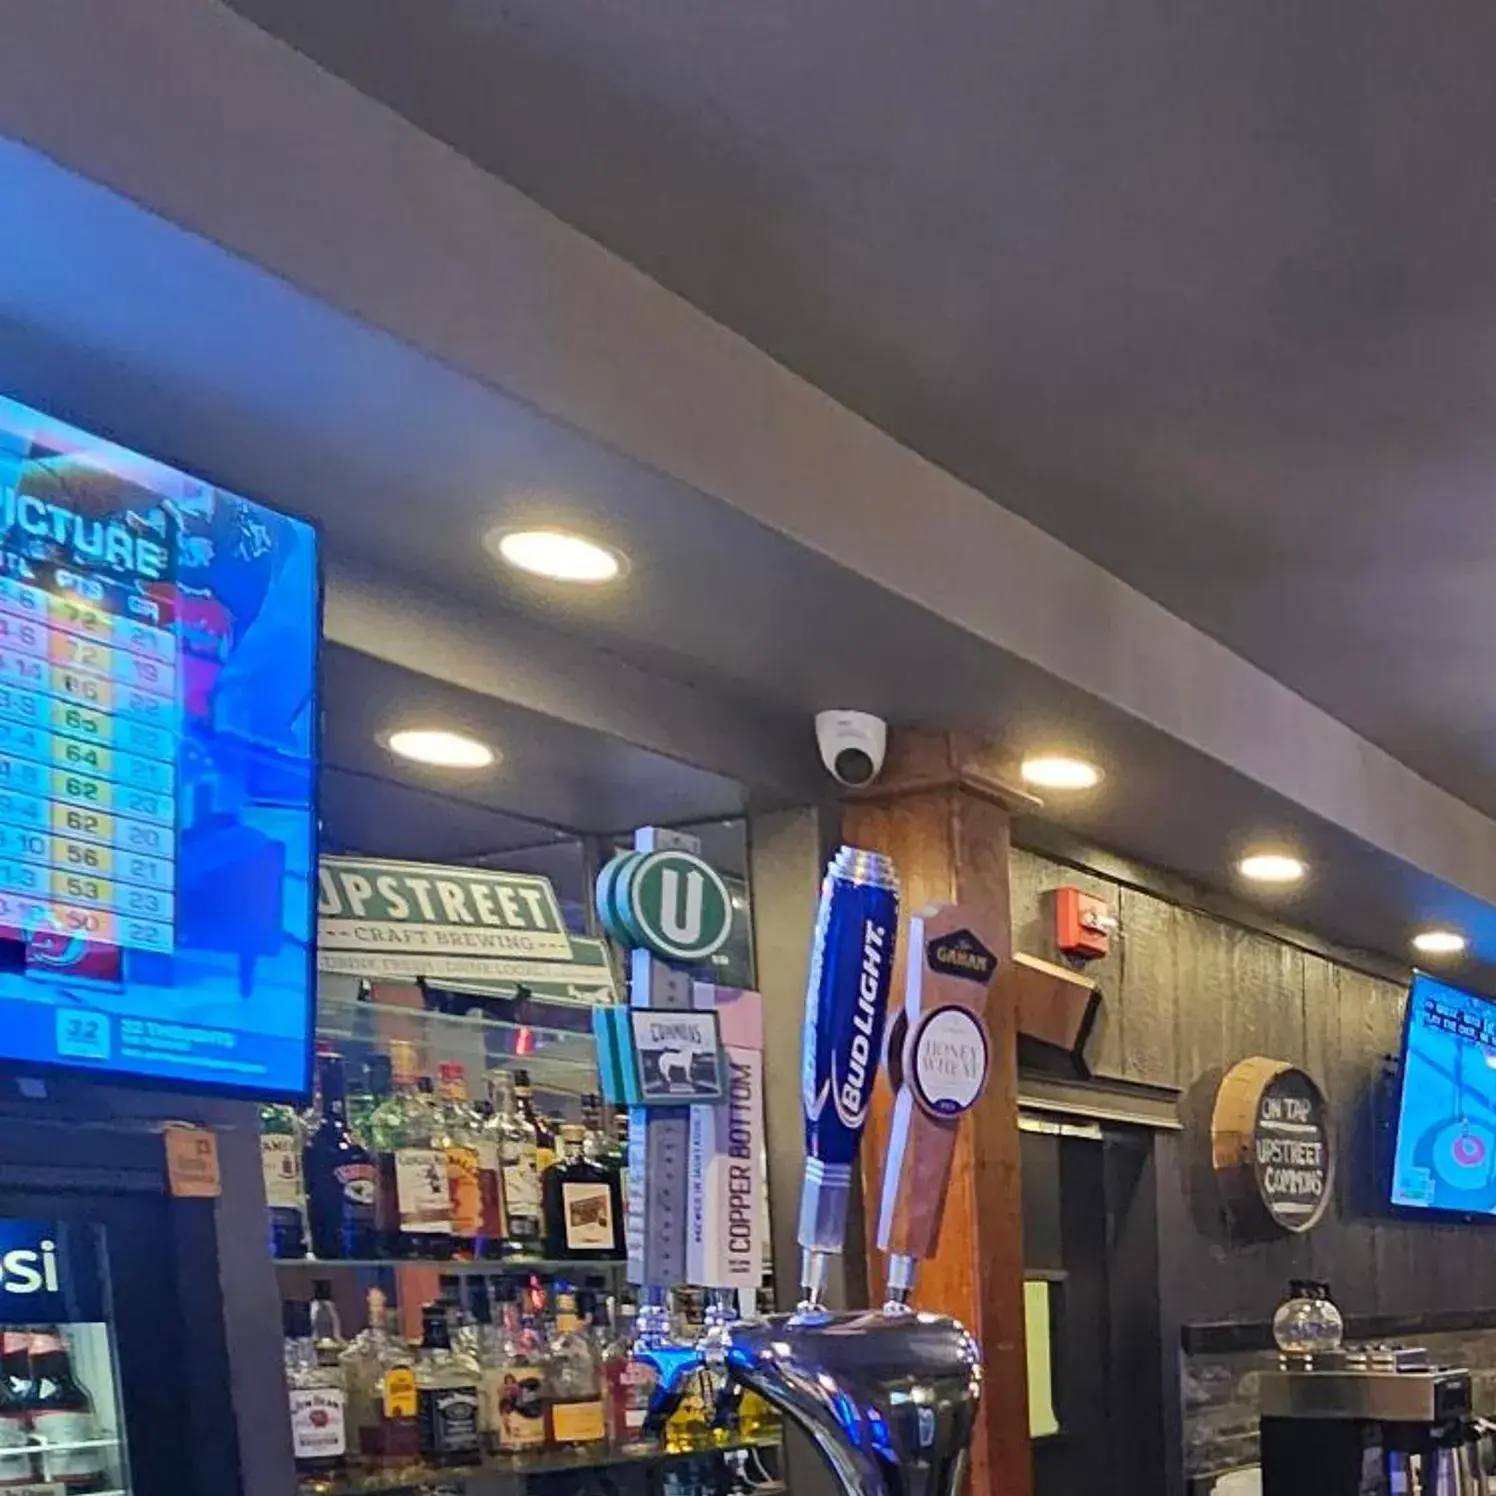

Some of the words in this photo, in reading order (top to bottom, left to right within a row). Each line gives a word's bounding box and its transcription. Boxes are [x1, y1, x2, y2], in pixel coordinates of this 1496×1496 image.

[0, 486, 161, 579] ICTURE
[66, 744, 98, 767] 64
[66, 777, 99, 801] 62
[66, 811, 99, 834] 62
[67, 844, 99, 867] 56
[66, 877, 99, 900] 53
[318, 866, 548, 929] UPSTREET
[660, 866, 704, 945] U
[353, 925, 428, 945] CRAFT
[434, 930, 534, 951] BREWING
[841, 1035, 870, 1113] BUD
[728, 1063, 752, 1159] BOTTOM
[1261, 1097, 1282, 1120] ON
[1284, 1098, 1312, 1122] TAP
[1256, 1138, 1323, 1166] UPSTREET
[1264, 1166, 1324, 1195] COMMONS
[728, 1164, 752, 1254] COPPER
[0, 1239, 59, 1293] si
